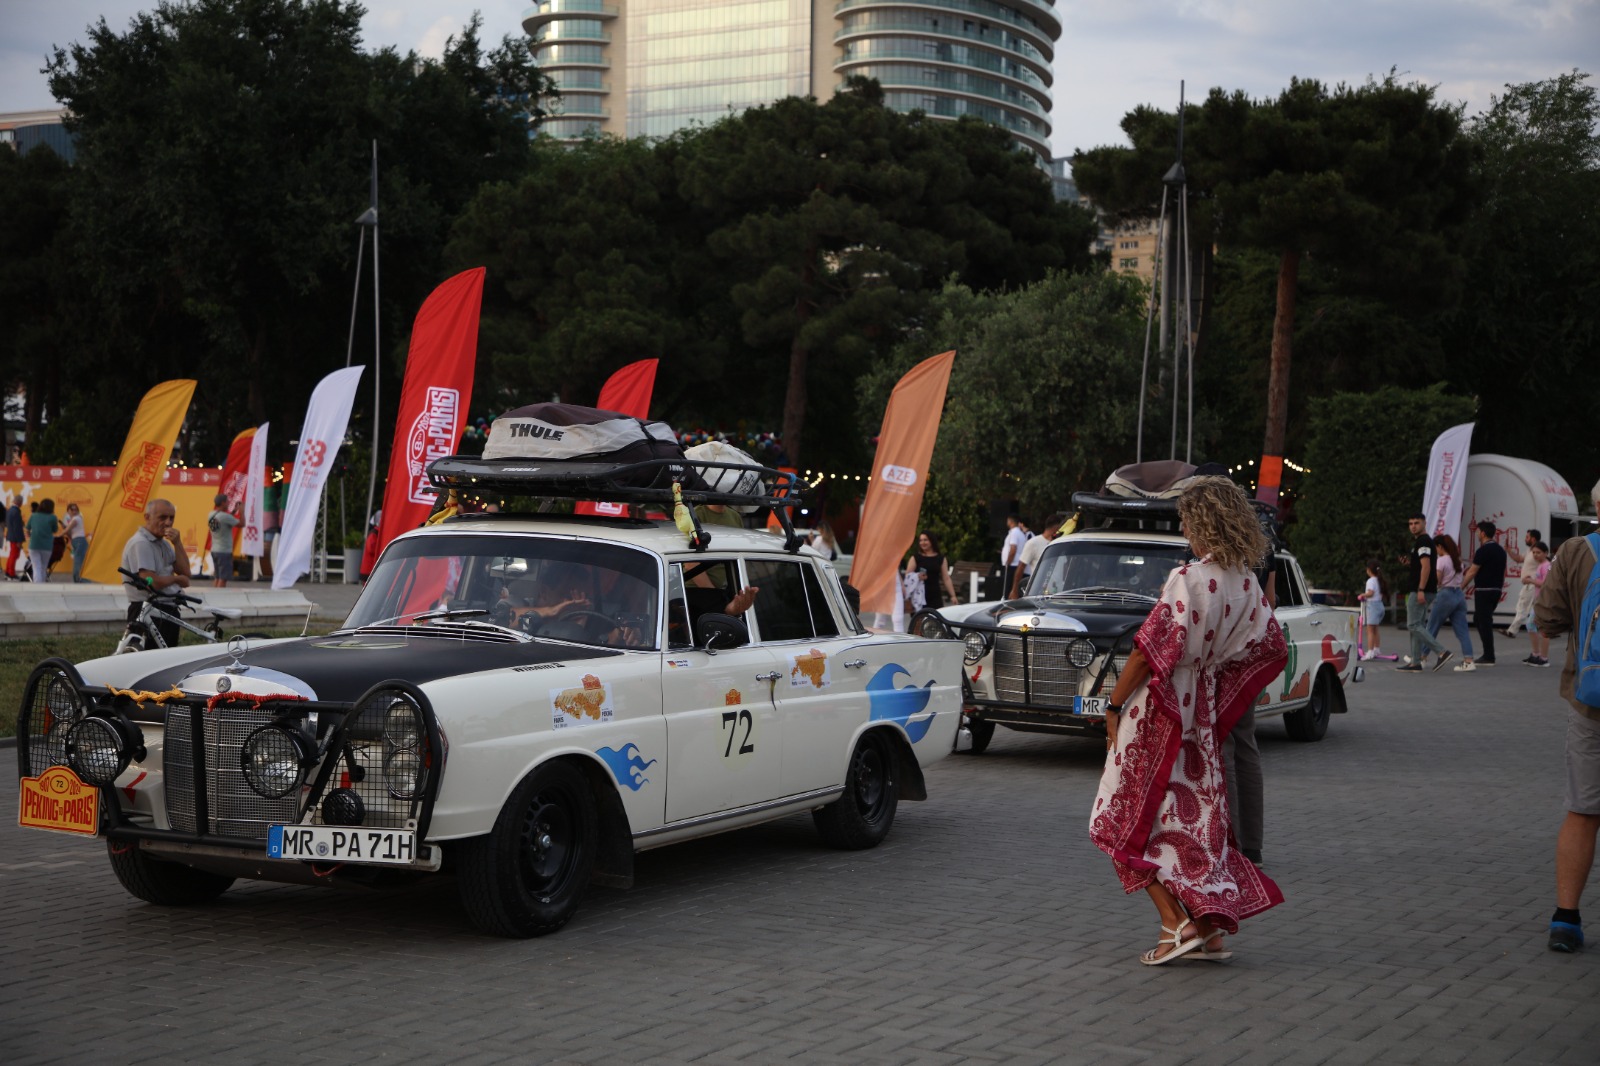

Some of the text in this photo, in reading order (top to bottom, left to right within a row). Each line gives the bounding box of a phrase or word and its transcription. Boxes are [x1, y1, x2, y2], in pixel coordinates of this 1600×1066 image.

[428, 390, 455, 439] PARIS
[509, 423, 564, 442] THULE
[887, 468, 911, 482] AZE
[1441, 451, 1455, 491] circuit
[1437, 491, 1452, 518] city
[1082, 701, 1100, 714] MR
[722, 709, 754, 757] 72
[56, 780, 64, 788] 72
[24, 787, 59, 821] PEKING
[63, 794, 94, 826] PARIS
[272, 829, 413, 860] D MR PA 71H
